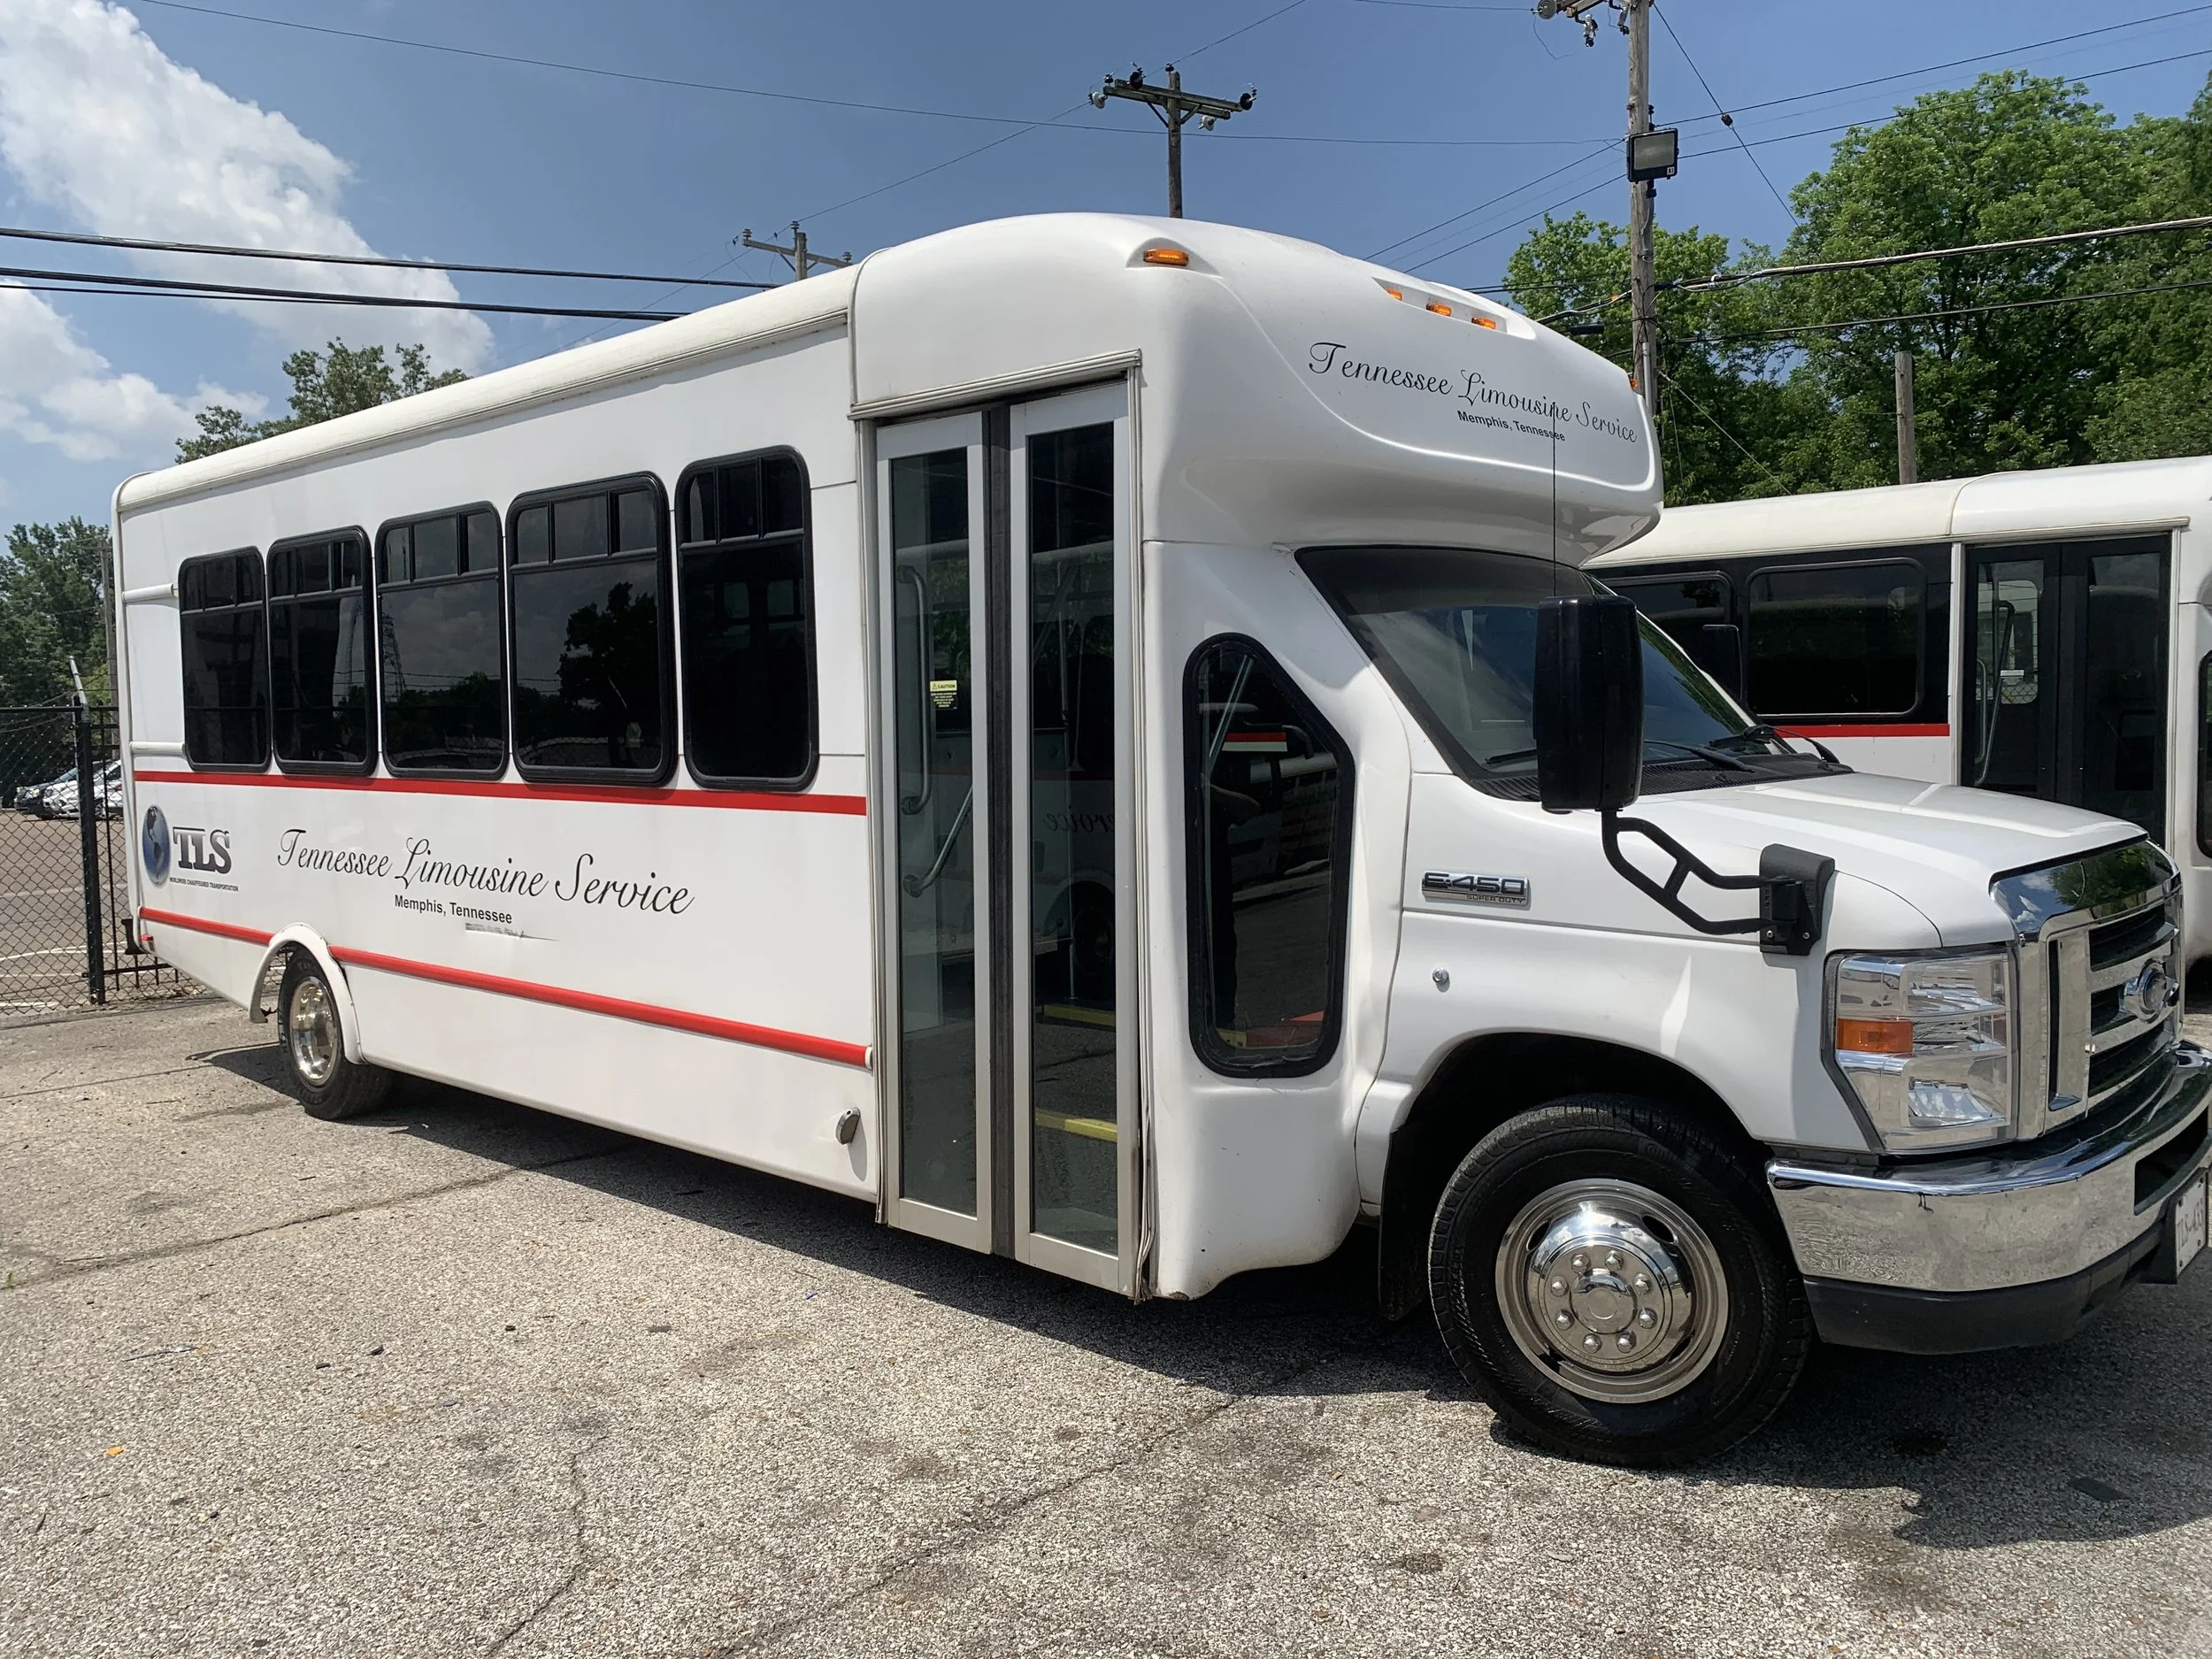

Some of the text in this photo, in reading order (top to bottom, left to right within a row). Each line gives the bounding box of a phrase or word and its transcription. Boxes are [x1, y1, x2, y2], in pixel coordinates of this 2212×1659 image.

[1308, 342, 1638, 443] Tennessee Limousine Service
[1456, 410, 1566, 442] Memphis, Tennessee
[172, 826, 232, 875] TLS
[277, 828, 696, 915] Tennessee Limousine Service
[394, 895, 512, 925] Memphis, Tennessee
[1498, 895, 1526, 904] DUTY
